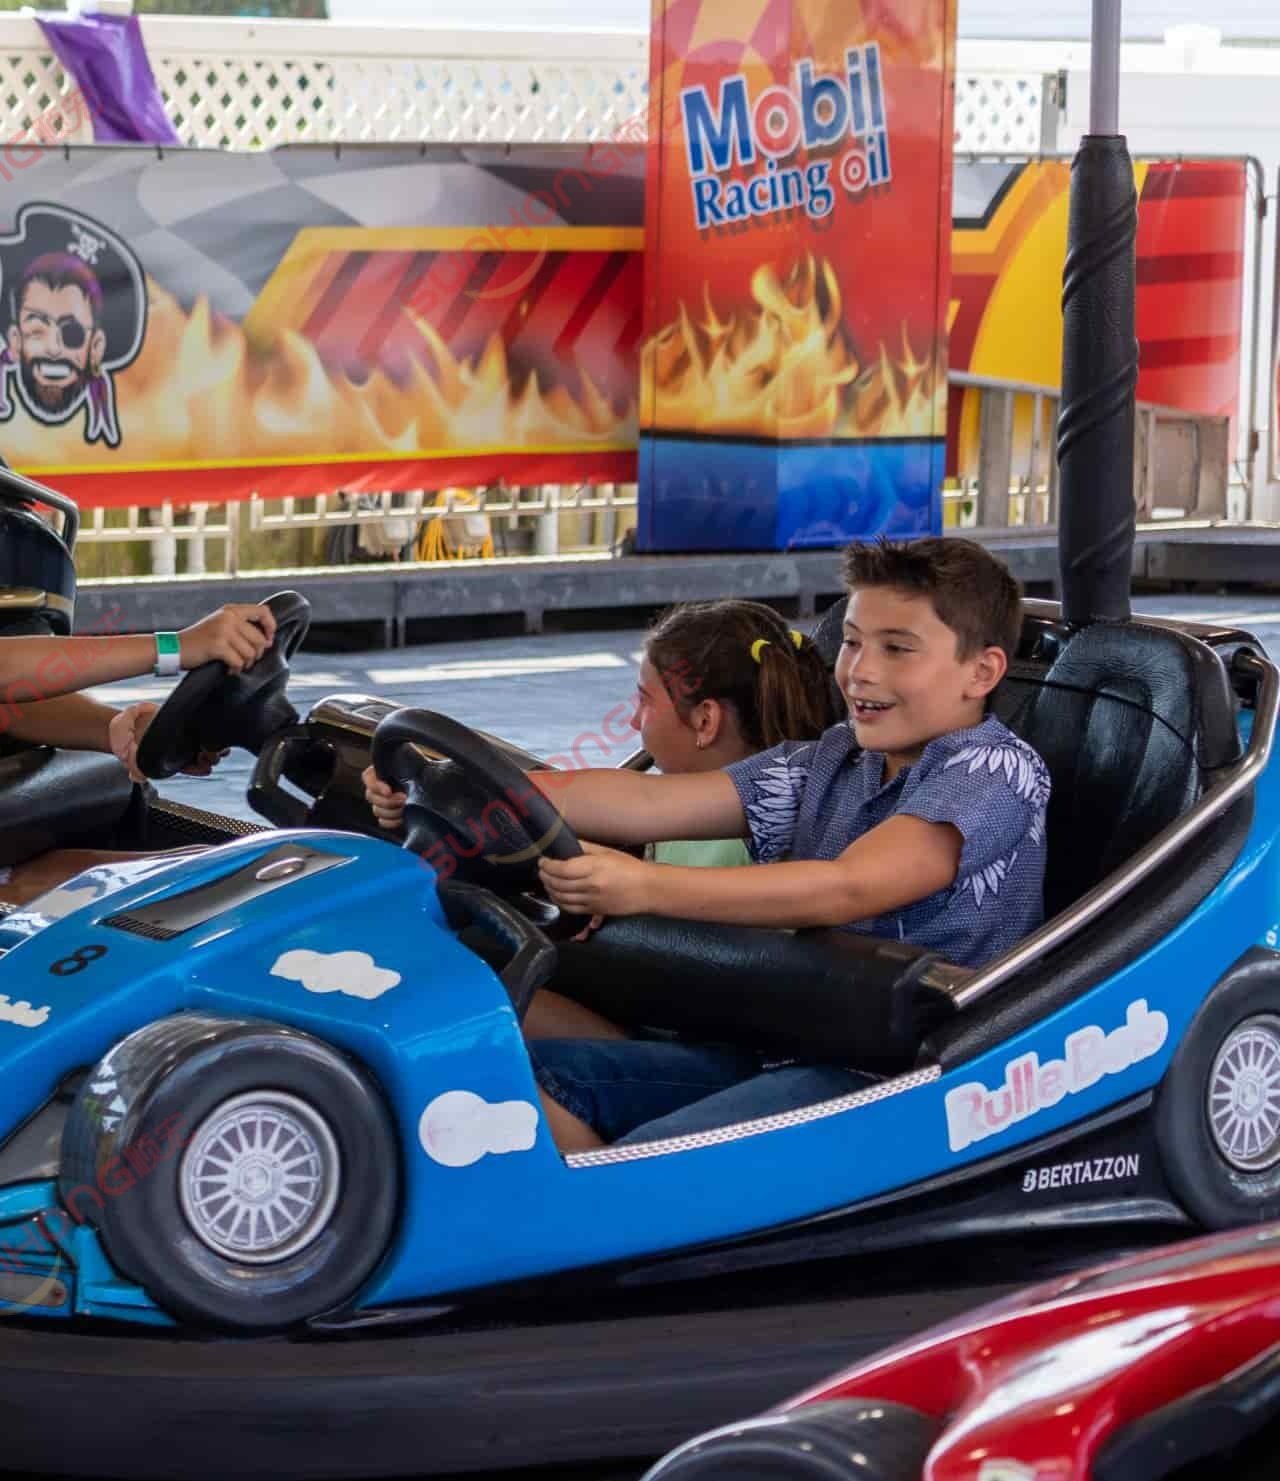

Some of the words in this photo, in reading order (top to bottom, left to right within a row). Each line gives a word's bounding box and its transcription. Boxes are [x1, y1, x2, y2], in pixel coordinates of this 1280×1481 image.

[681, 41, 885, 175] Mobil
[692, 158, 834, 229] Racing
[841, 130, 890, 191] oil
[48, 944, 109, 977] 8
[1037, 1153, 1140, 1190] BERTAZZON
